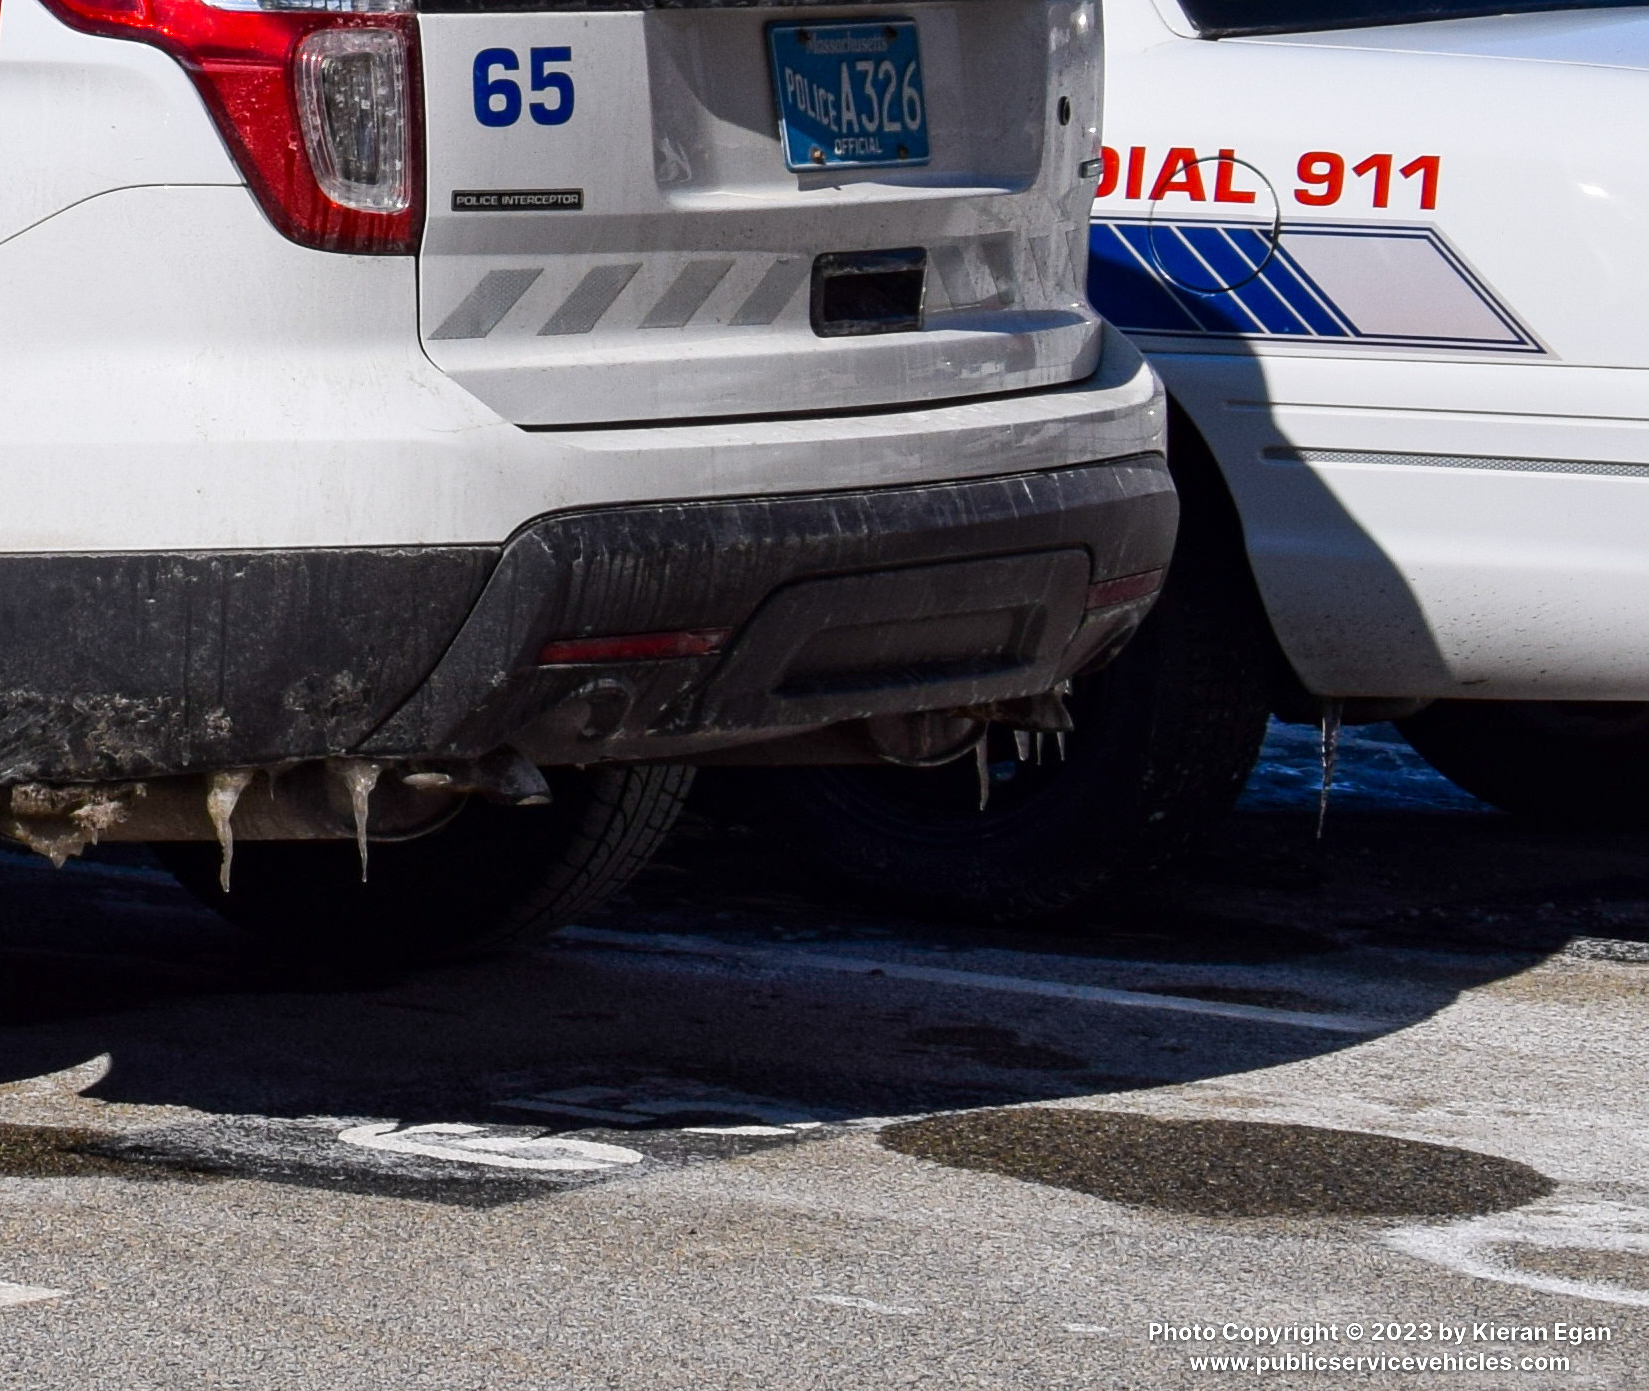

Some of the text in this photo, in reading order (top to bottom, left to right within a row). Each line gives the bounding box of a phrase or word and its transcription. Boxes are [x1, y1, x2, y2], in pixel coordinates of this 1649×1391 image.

[472, 46, 575, 128] 65
[784, 59, 922, 134] POLICE A326
[833, 137, 884, 155] OFFICIAL
[456, 194, 579, 206] POLICE INTERCEPTOR
[1293, 150, 1441, 211] 911
